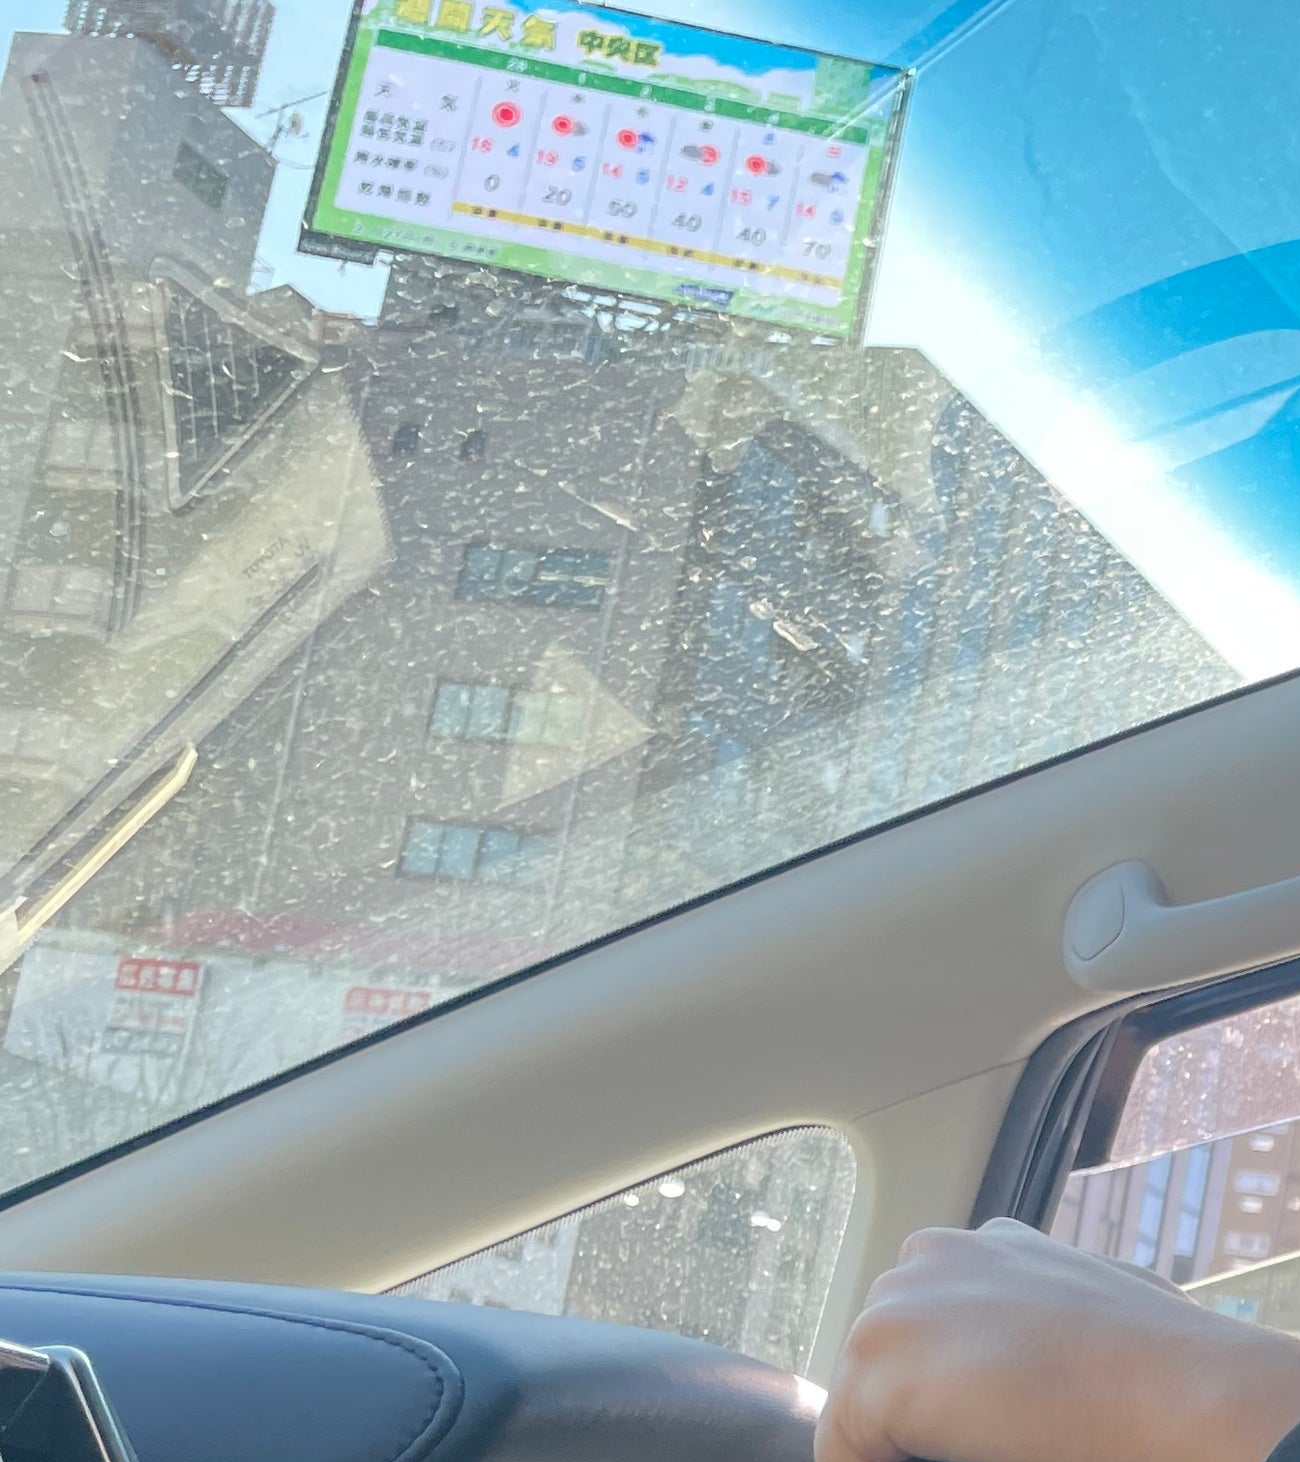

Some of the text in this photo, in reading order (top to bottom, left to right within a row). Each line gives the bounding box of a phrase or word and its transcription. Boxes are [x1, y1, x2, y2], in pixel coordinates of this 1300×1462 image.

[577, 29, 662, 68] 中央区
[484, 174, 501, 192] 0
[542, 185, 572, 206] 20
[671, 211, 702, 232] 40
[736, 227, 767, 246] 40
[803, 241, 832, 260] 70
